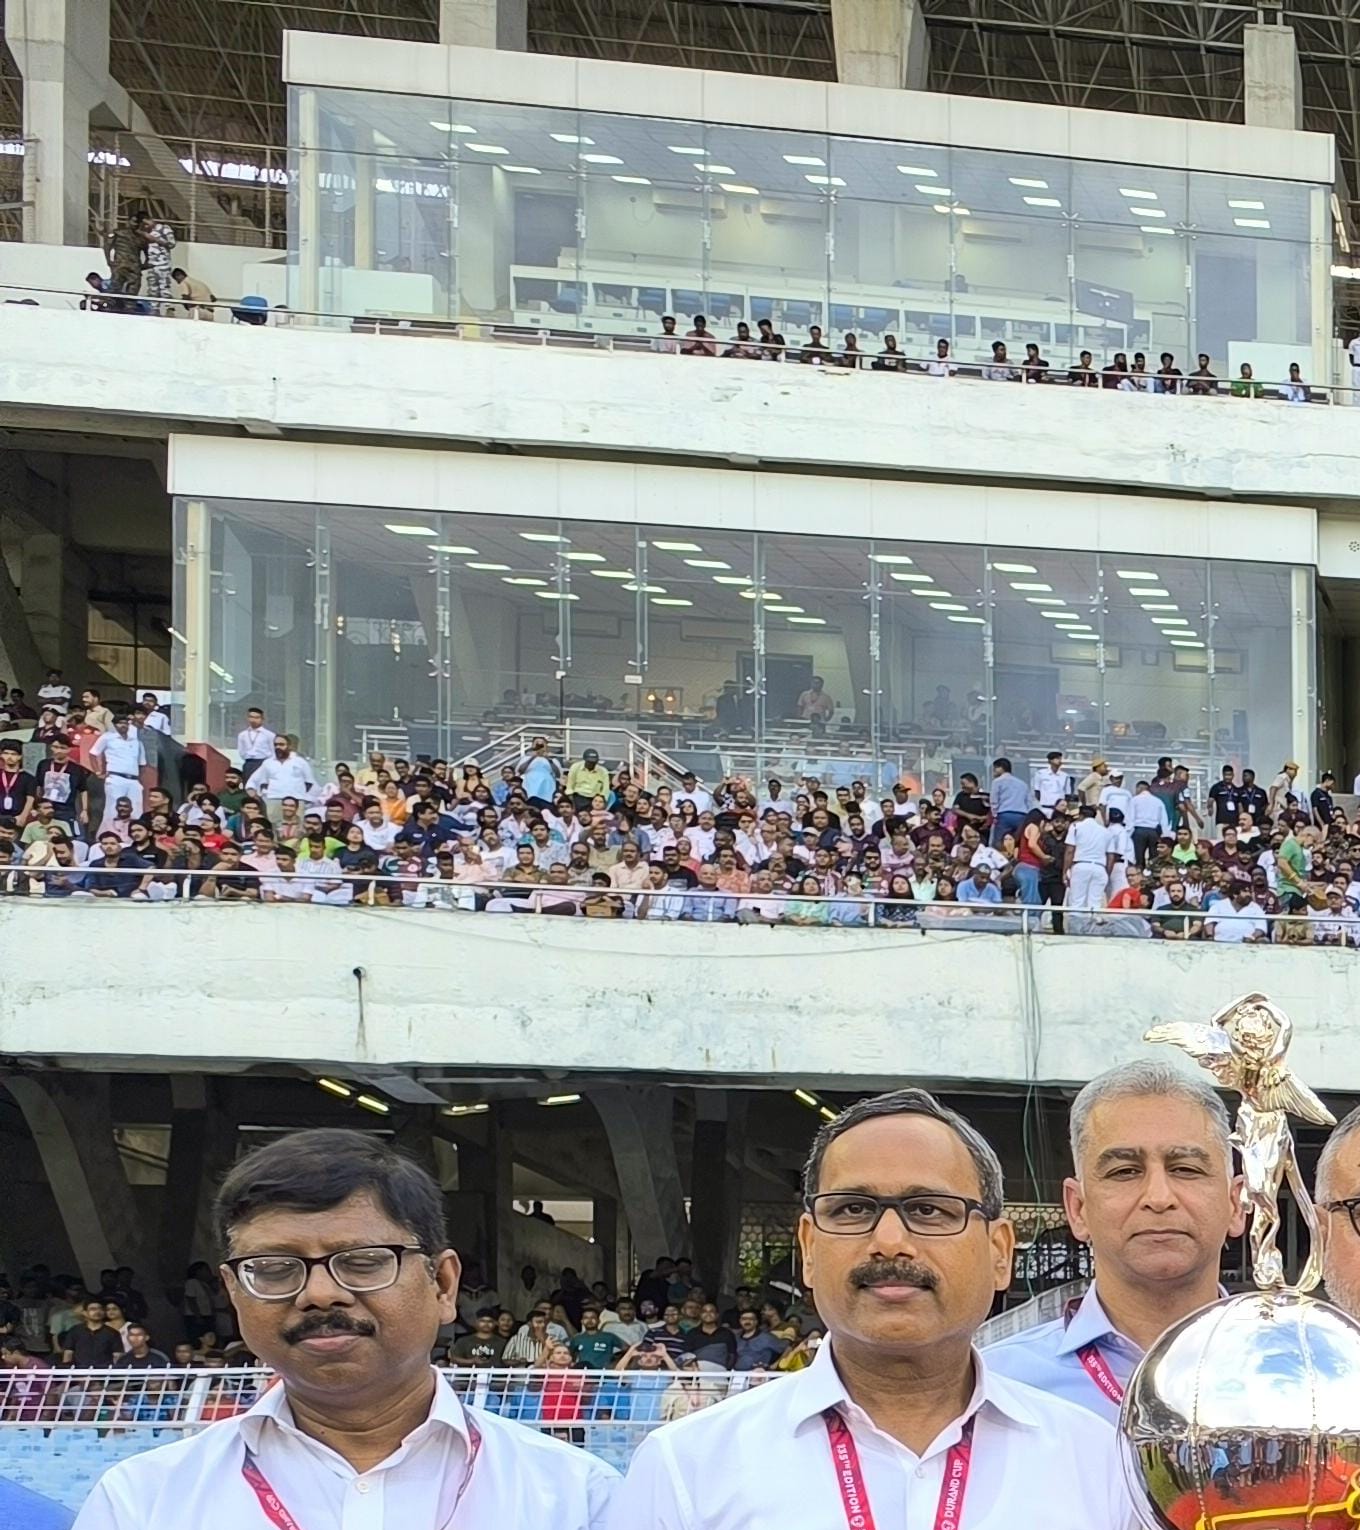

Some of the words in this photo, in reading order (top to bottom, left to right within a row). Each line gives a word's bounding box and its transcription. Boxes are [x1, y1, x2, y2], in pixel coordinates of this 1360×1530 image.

[843, 1467, 862, 1514] EDITION
[944, 1480, 960, 1518] DURAND
[952, 1459, 964, 1477] CUP
